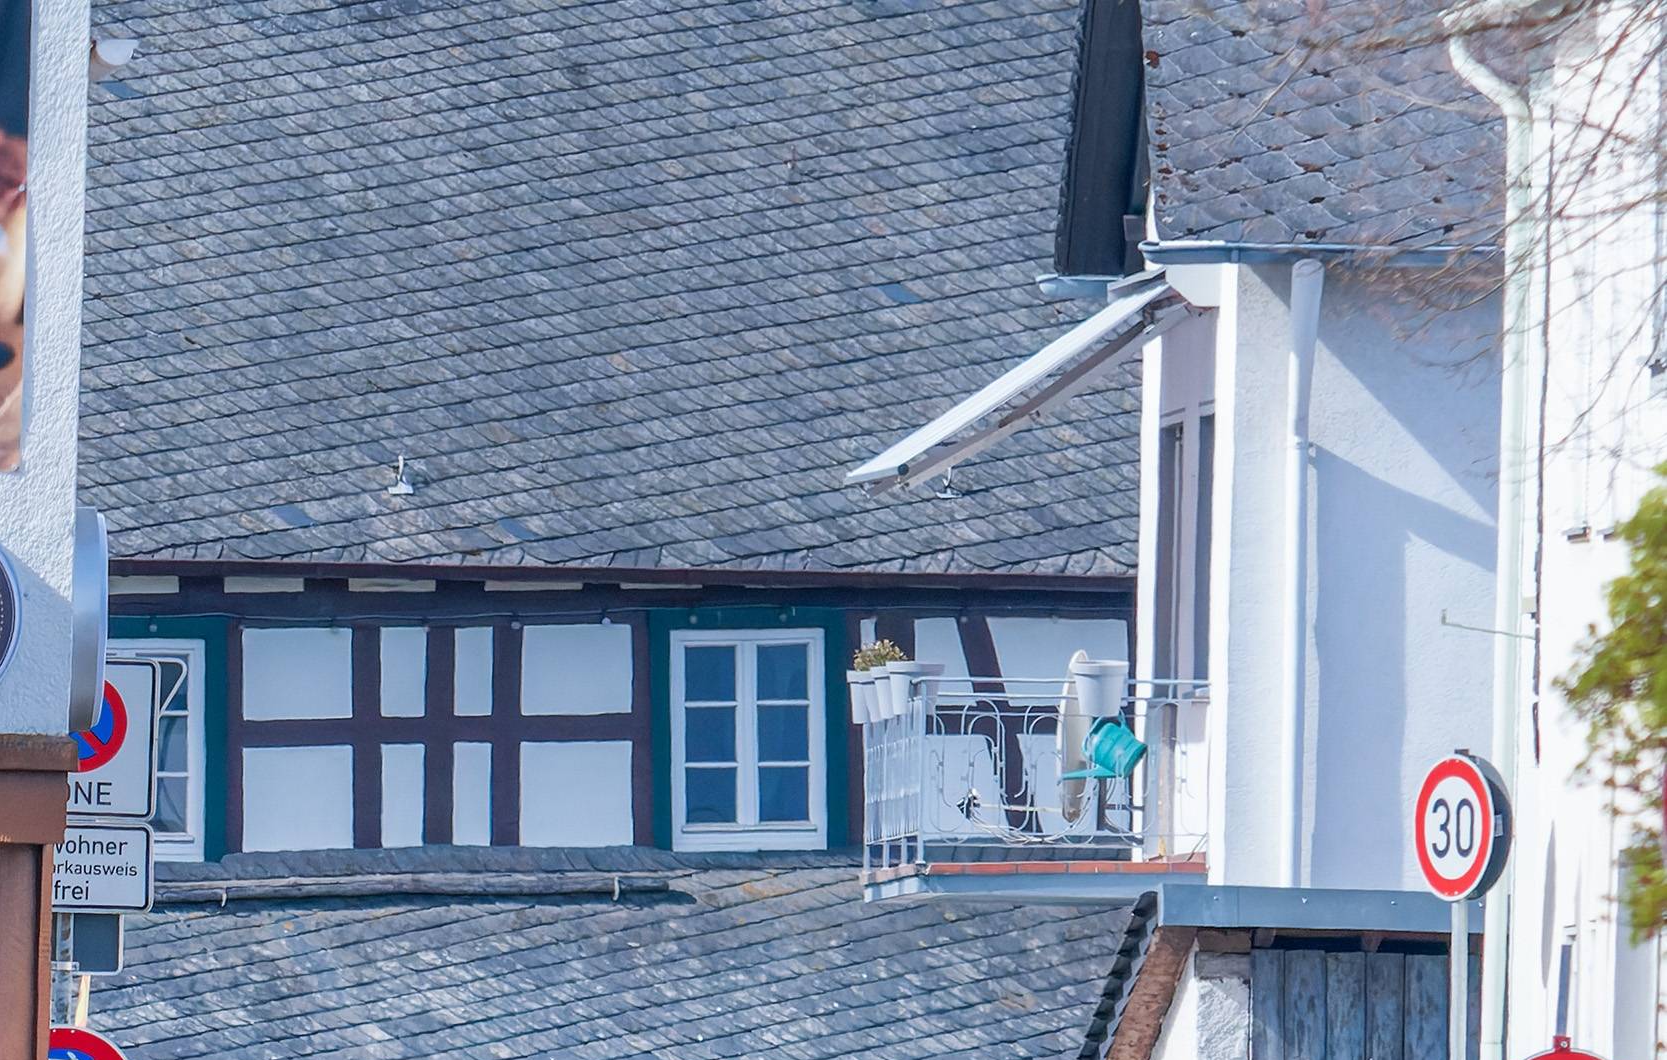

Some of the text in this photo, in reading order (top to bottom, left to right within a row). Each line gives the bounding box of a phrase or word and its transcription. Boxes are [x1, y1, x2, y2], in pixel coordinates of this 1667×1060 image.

[67, 781, 112, 805] NE
[1432, 798, 1474, 859] 30
[53, 880, 89, 900] frei
